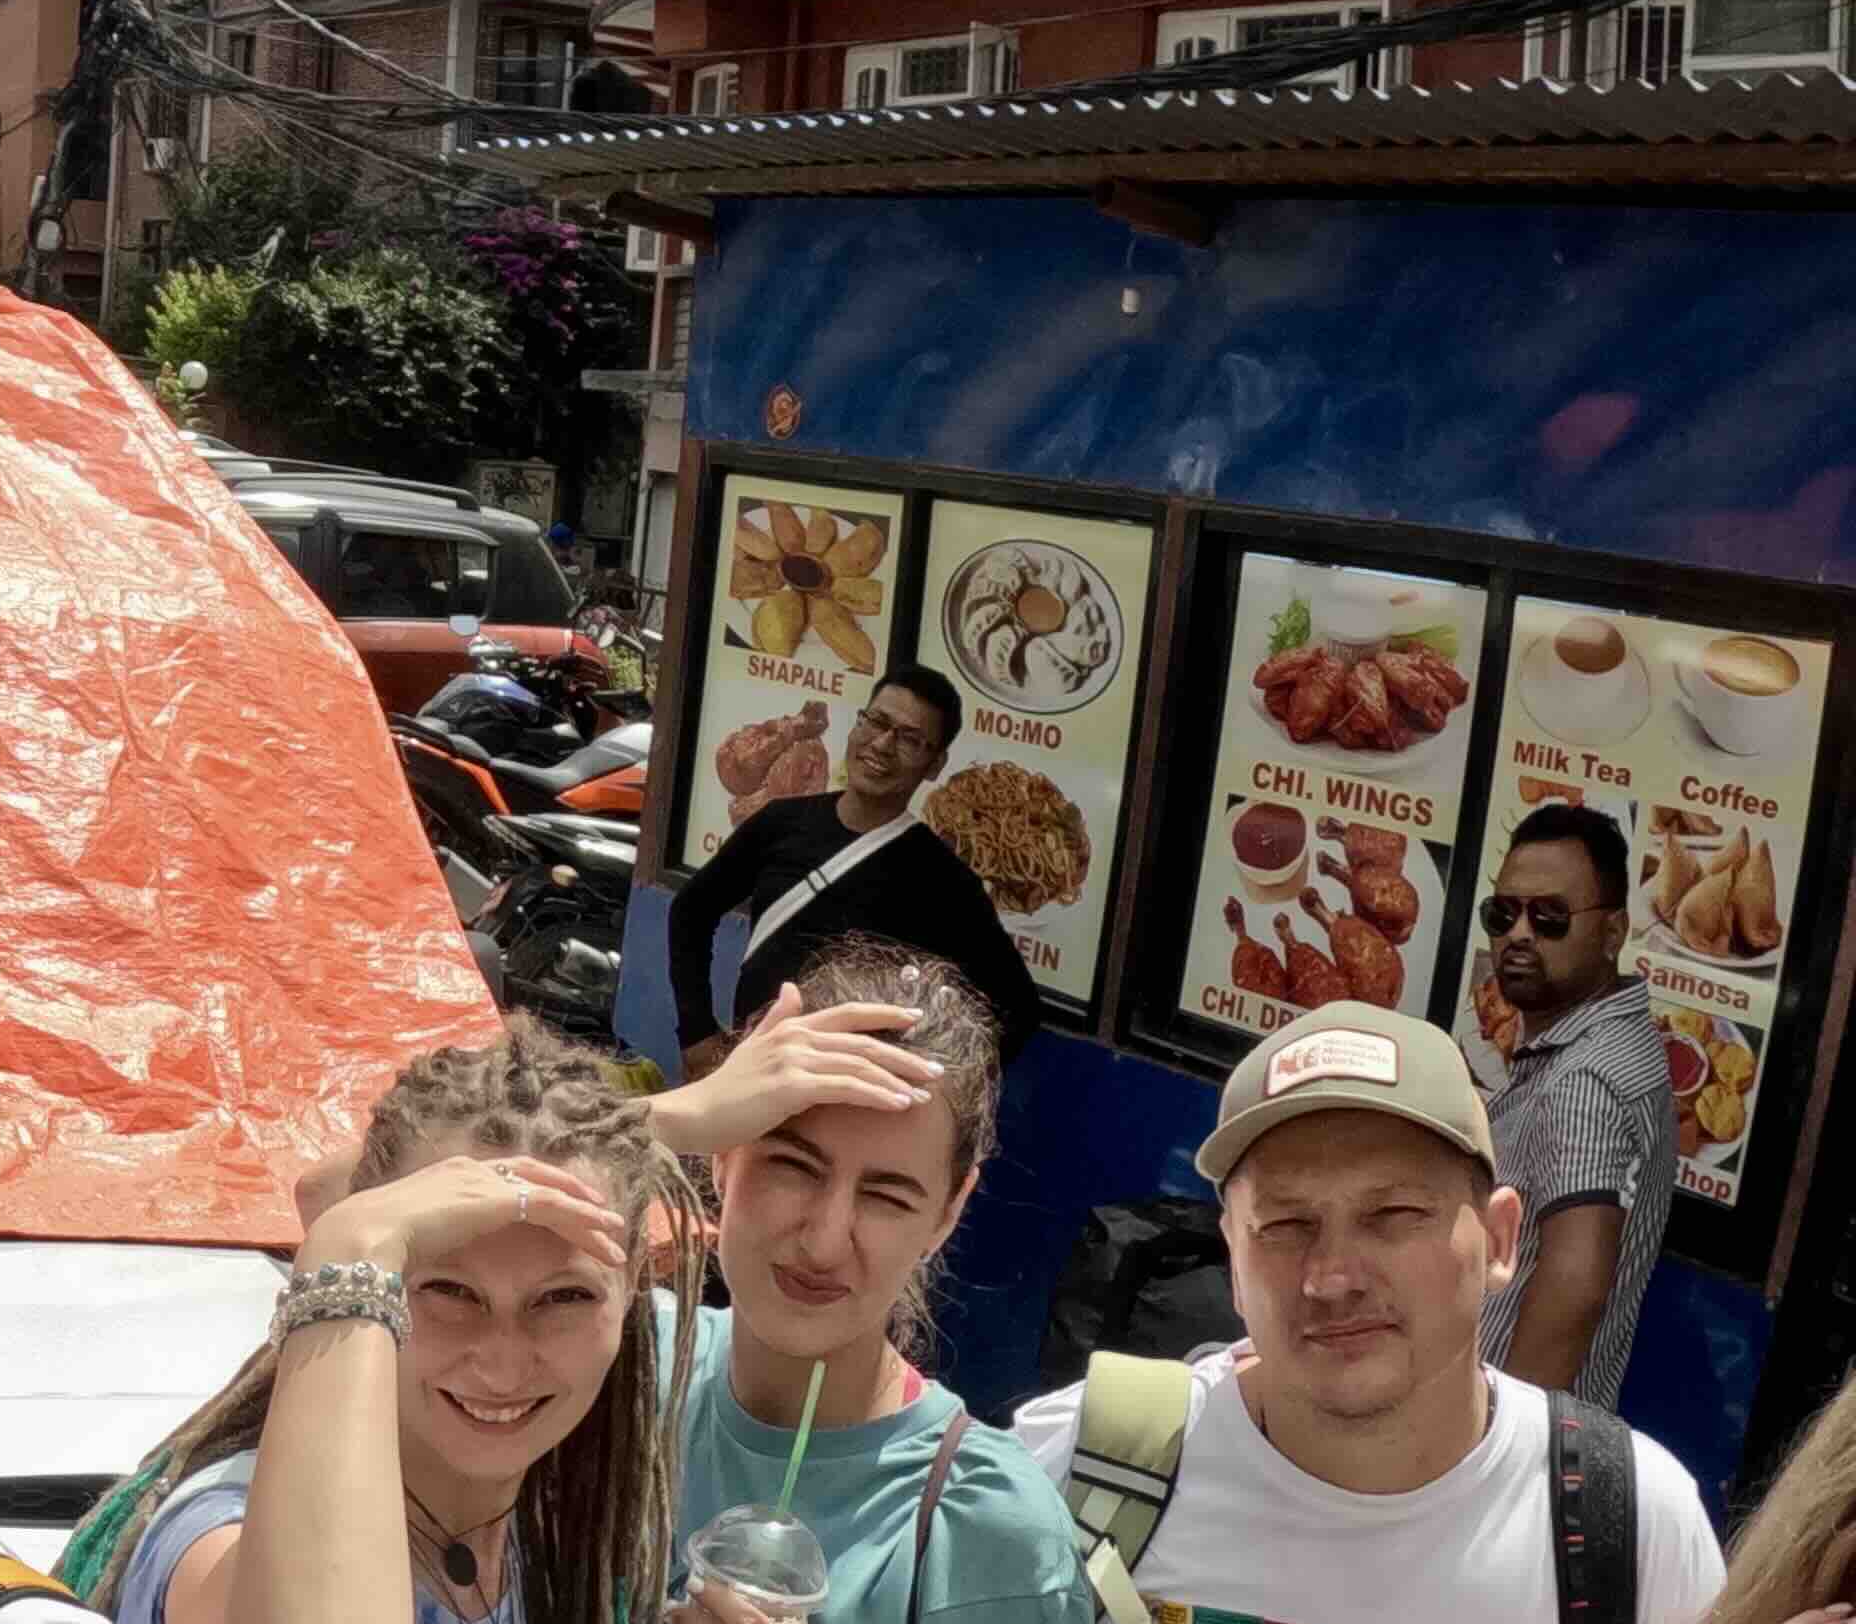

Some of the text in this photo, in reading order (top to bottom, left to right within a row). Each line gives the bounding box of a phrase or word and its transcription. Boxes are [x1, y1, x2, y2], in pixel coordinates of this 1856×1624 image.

[747, 654, 845, 696] SHAPALE
[974, 708, 1062, 750] MO:MO
[1513, 741, 1632, 788] Milk Tea
[1252, 762, 1433, 827] CHI. WINGS
[1680, 775, 1779, 819] Coffee
[1201, 986, 1250, 1024] CHI.
[1635, 956, 1751, 1011] Samosa
